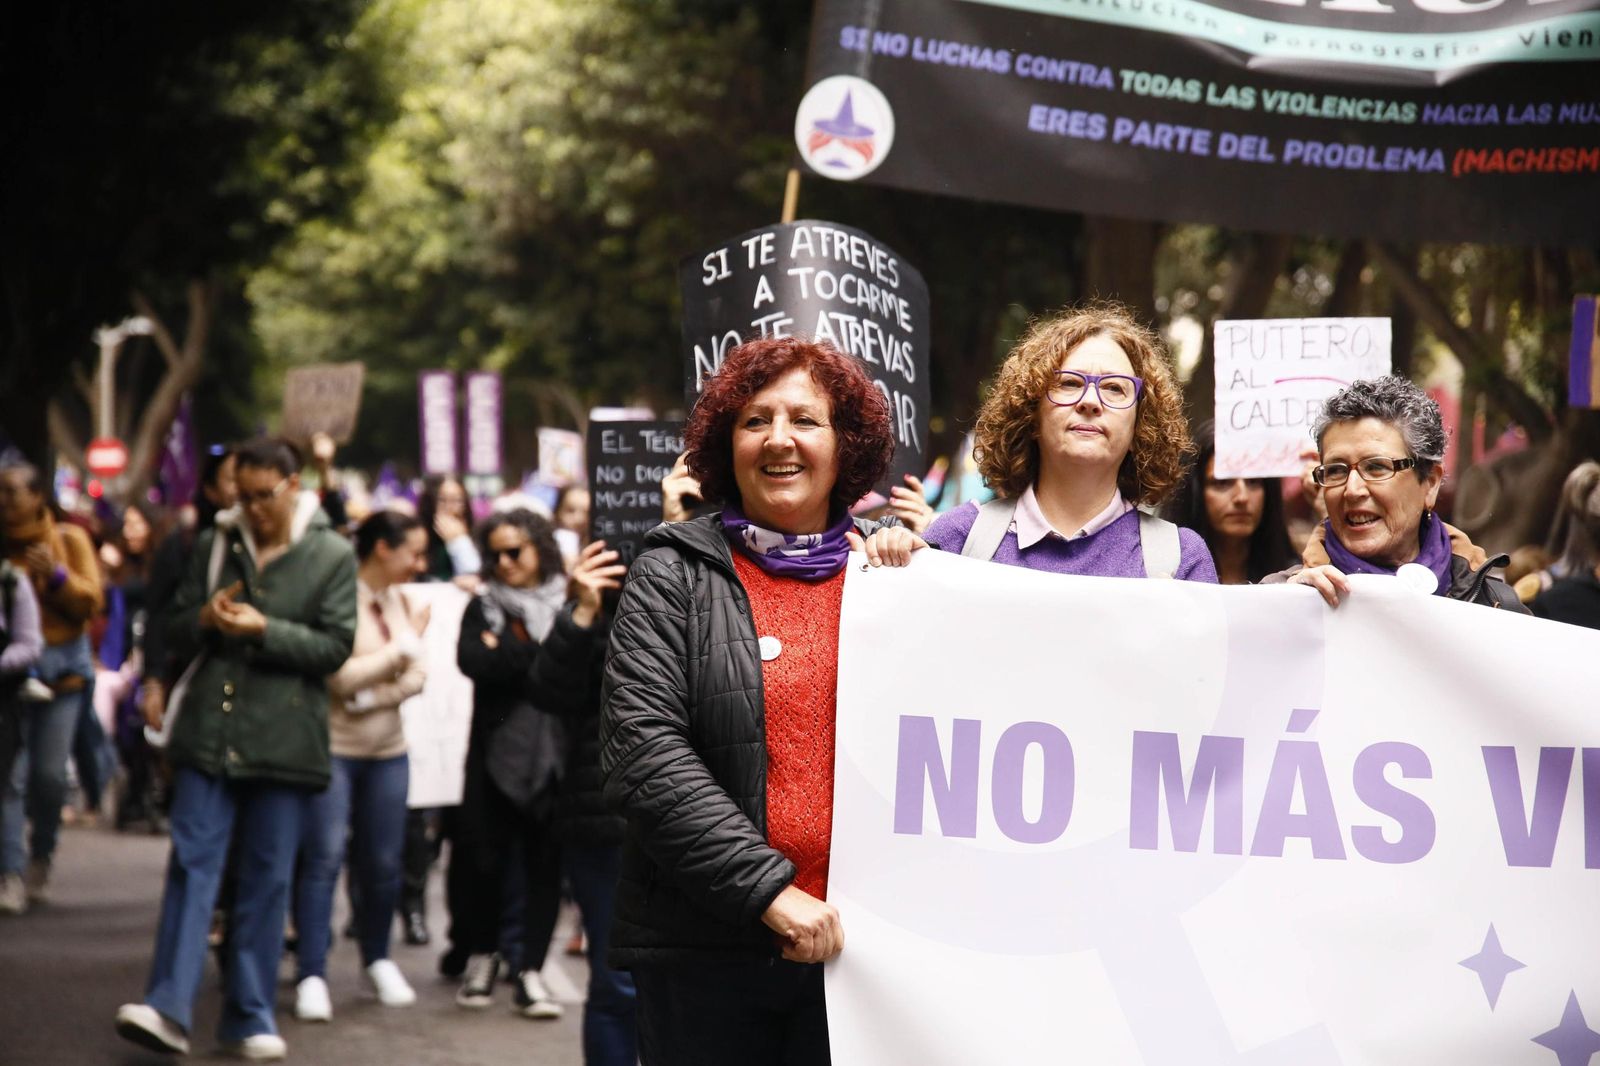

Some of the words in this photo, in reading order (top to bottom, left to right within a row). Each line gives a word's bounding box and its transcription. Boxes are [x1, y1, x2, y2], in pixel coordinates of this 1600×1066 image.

[840, 25, 869, 51] SI
[872, 32, 908, 57] NO
[912, 35, 1011, 74] LUCHAS
[1015, 53, 1114, 91] CONTRA
[1119, 69, 1202, 101] TODAS
[1206, 82, 1257, 110] LAS
[1261, 88, 1418, 124] VIOLENCIAS
[1423, 102, 1500, 125] HACIA
[1505, 102, 1553, 125] LAS
[1027, 103, 1107, 141] ERES
[1112, 116, 1213, 157] PARTE
[1216, 130, 1276, 163] DEL
[1283, 138, 1446, 173] PROBLEMA
[702, 248, 733, 286] SI
[742, 232, 776, 269] TE
[790, 226, 900, 289] ATREVES
[752, 274, 775, 309] A
[787, 266, 914, 333] TOCARME
[812, 310, 917, 383] ATREVAS
[1230, 368, 1267, 391] AL
[595, 464, 626, 485] NO
[601, 429, 634, 454] EL
[893, 714, 1076, 845] NO
[1129, 708, 1437, 865] MÁS
